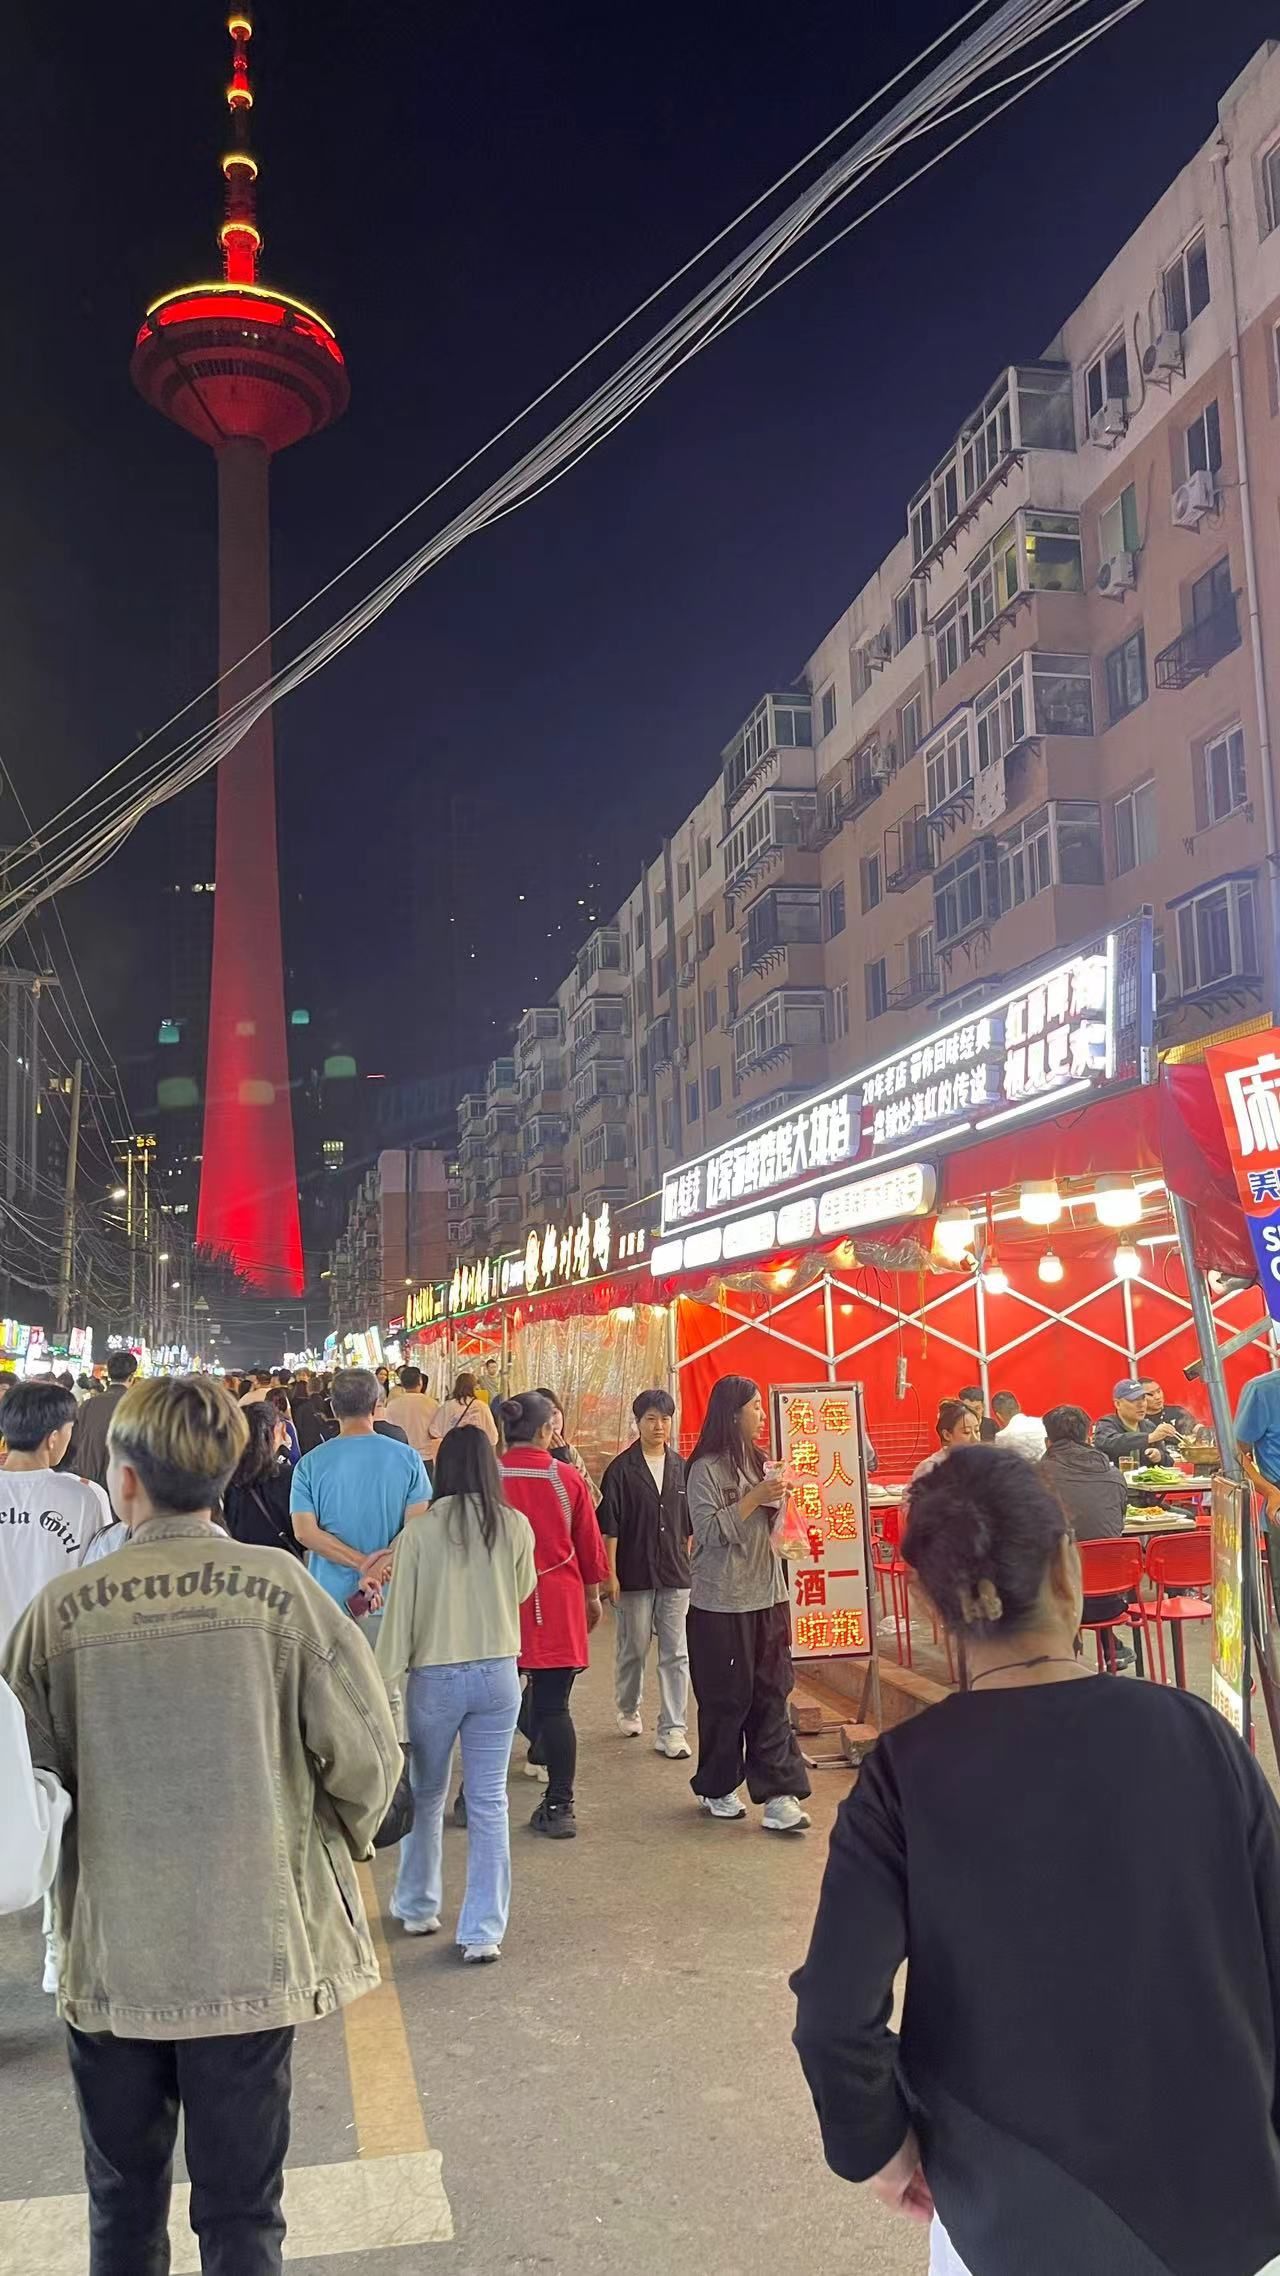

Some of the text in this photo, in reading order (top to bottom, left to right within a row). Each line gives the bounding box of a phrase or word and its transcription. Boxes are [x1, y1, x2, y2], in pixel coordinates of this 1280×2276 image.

[1249, 1169, 1280, 1202] 美
[39, 1510, 81, 1554] Girl
[820, 1398, 865, 1649] 每人送一瓶
